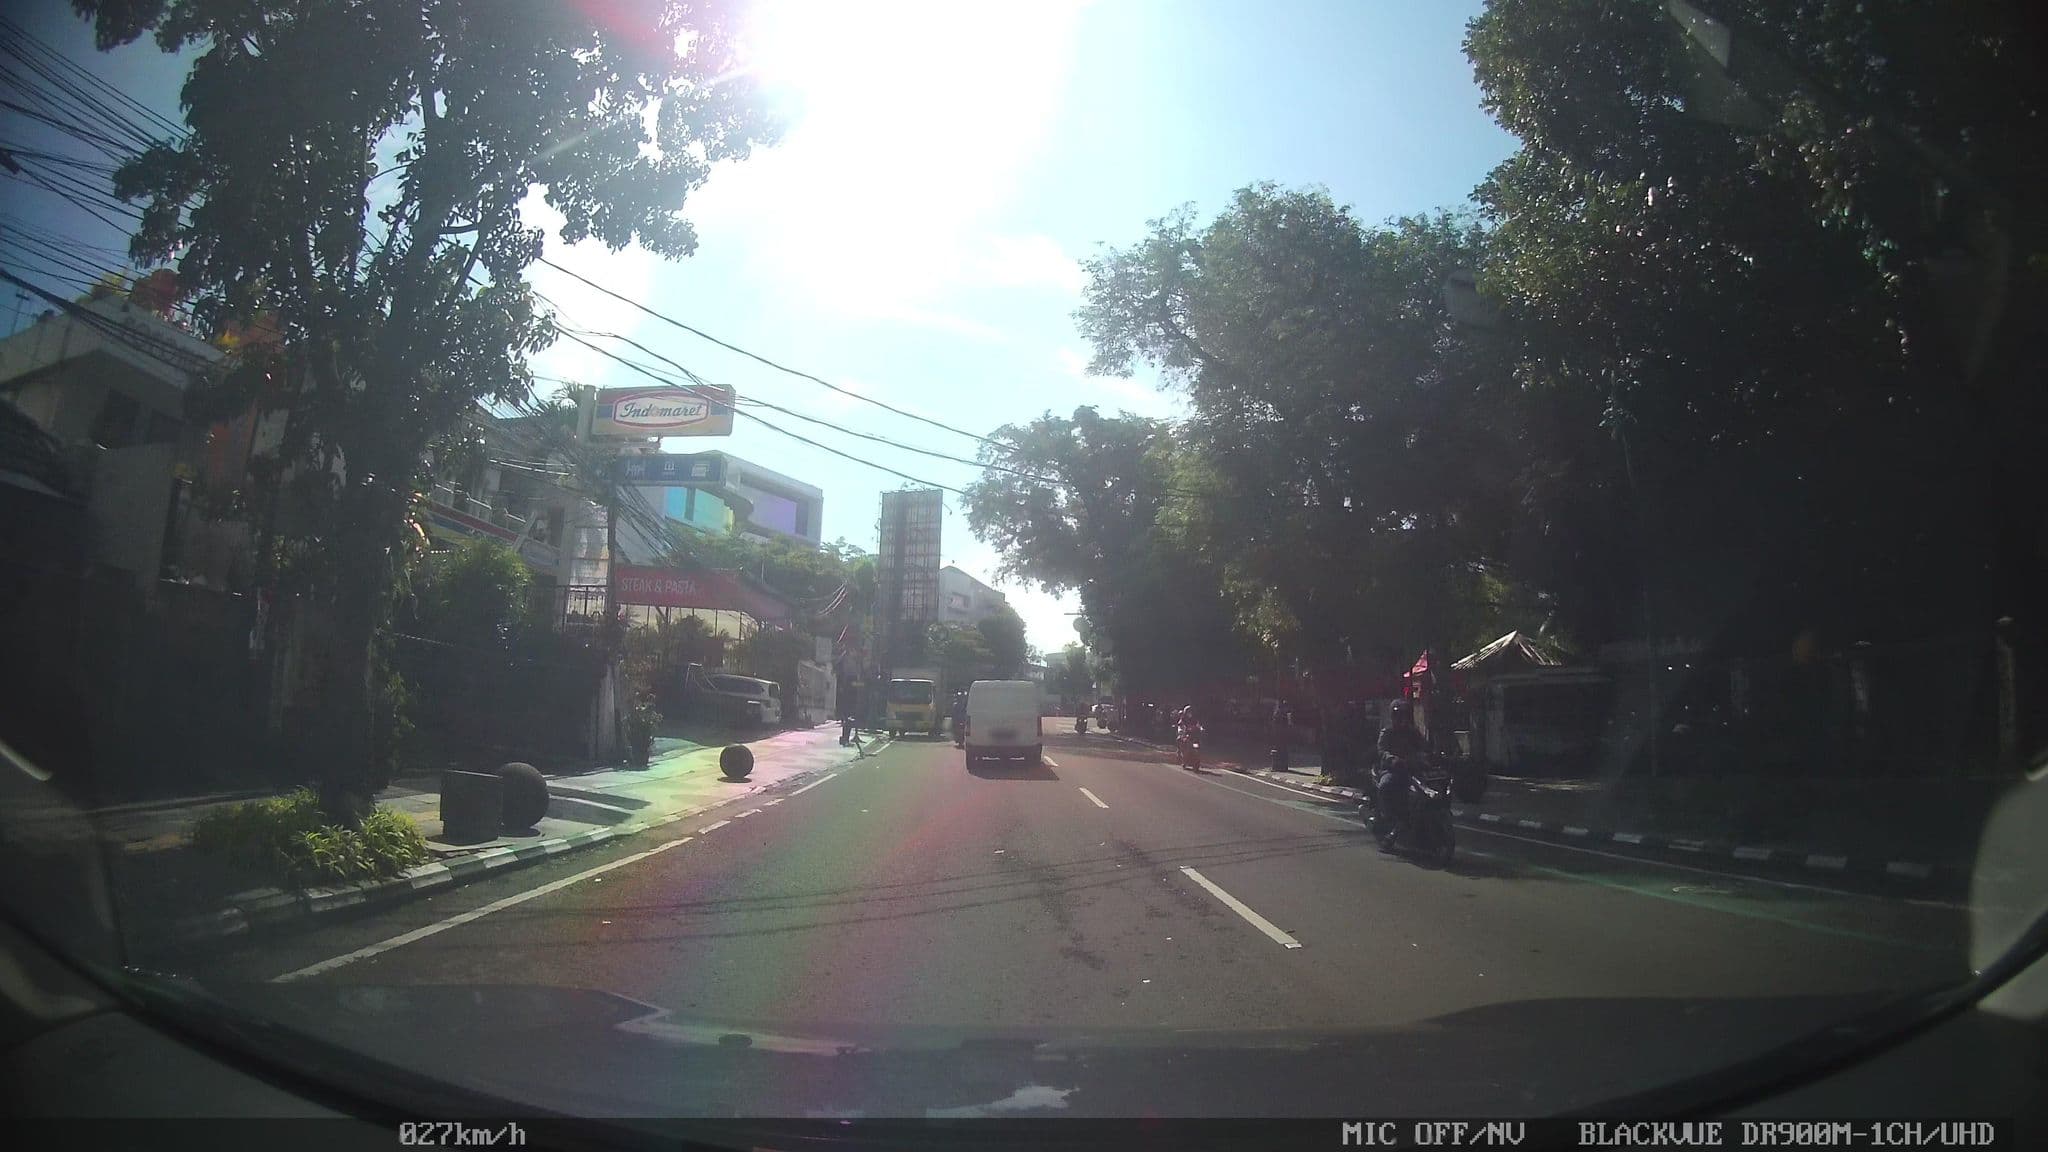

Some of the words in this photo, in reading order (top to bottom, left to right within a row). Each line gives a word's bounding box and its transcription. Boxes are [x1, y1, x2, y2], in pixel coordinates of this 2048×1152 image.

[619, 402, 704, 419] Indomaret
[621, 577, 652, 593] STEAK
[655, 578, 662, 593] &
[665, 578, 697, 594] PASTA
